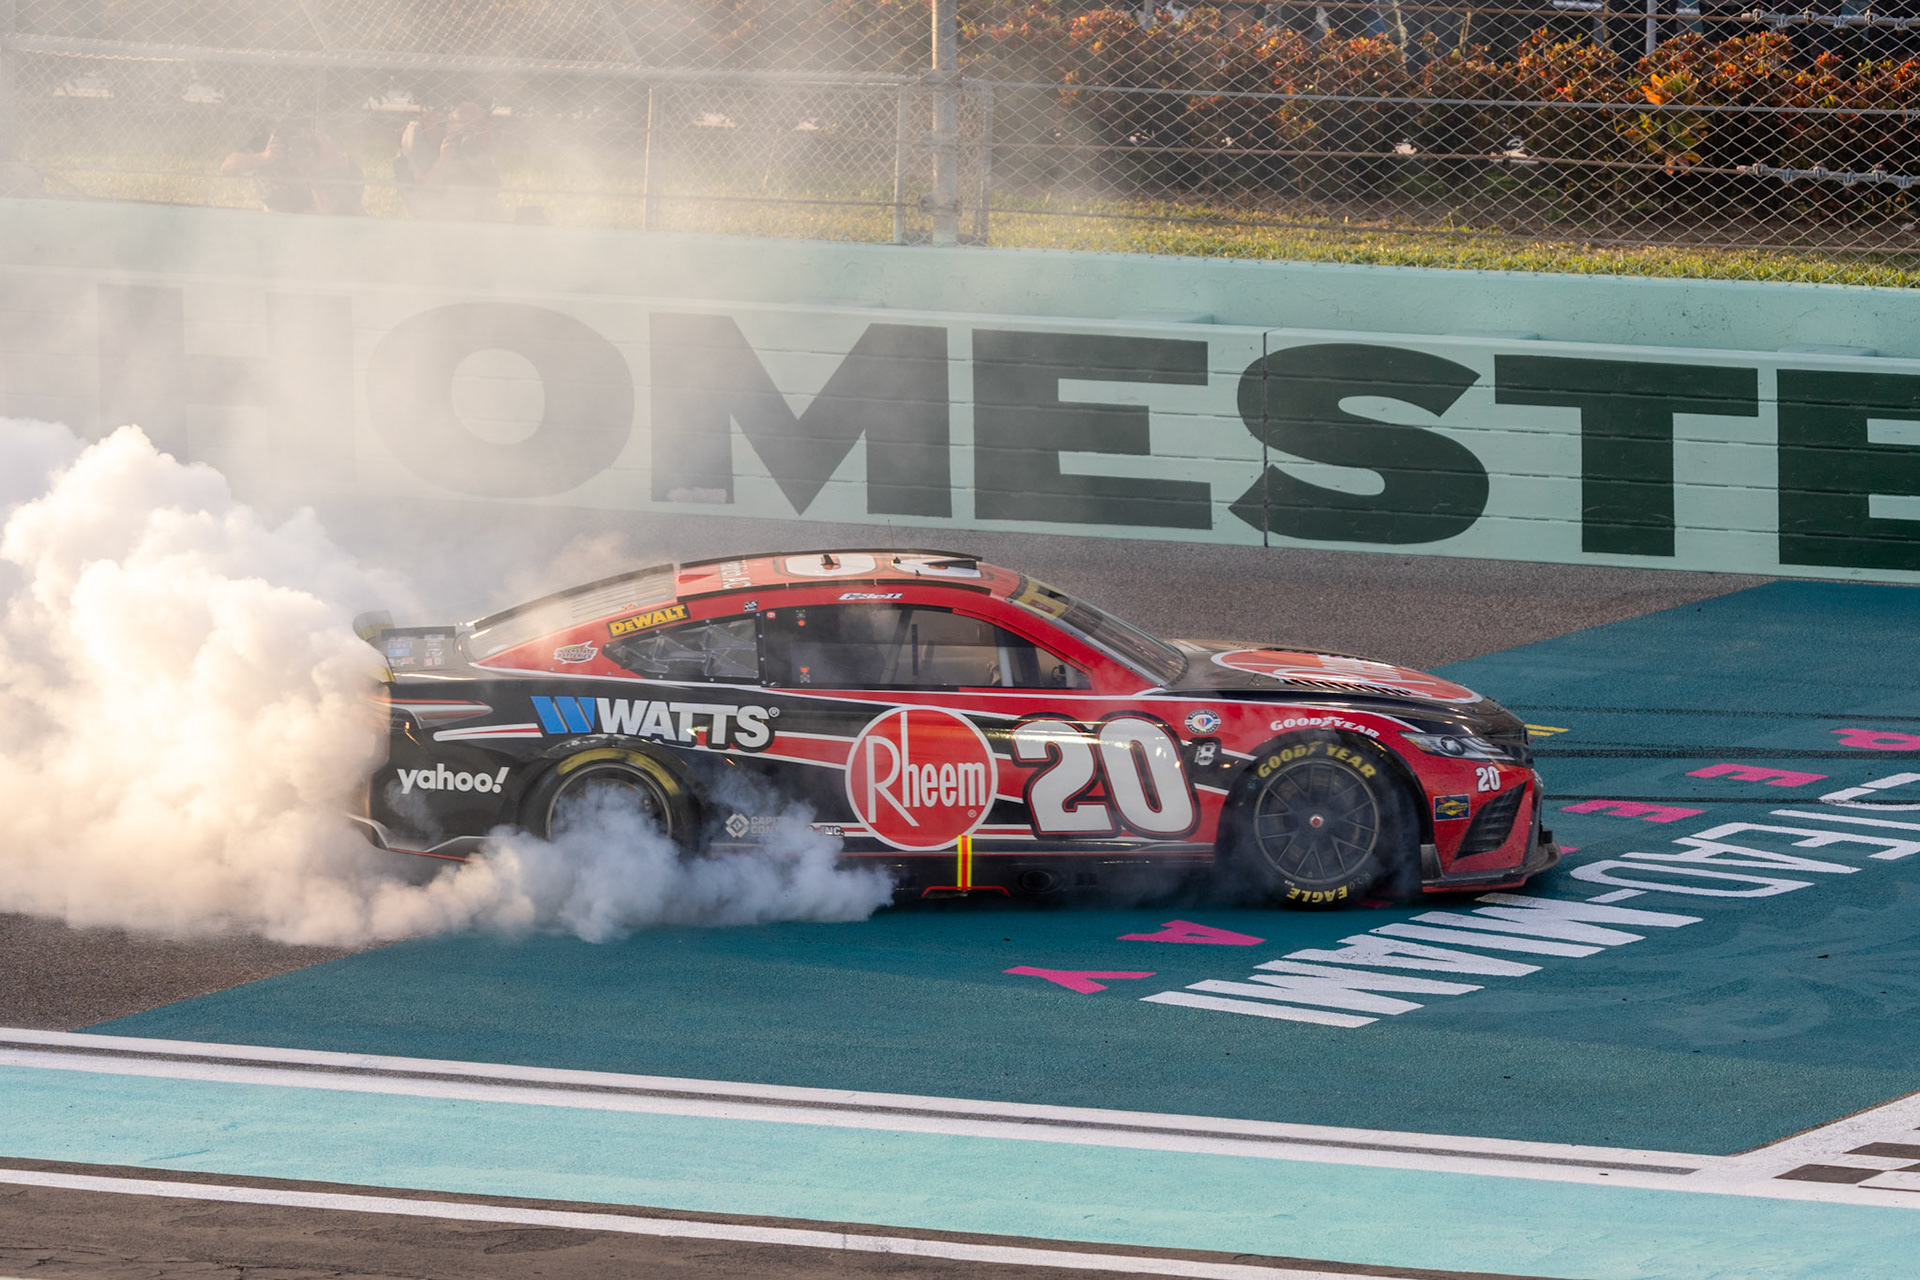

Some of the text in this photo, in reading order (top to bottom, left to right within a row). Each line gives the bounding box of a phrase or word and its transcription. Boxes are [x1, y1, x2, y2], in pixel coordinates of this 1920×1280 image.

[596, 698, 771, 748] WATTS
[1270, 716, 1380, 738] GOODYEAR
[397, 763, 509, 794] yahoo!
[866, 711, 986, 827] Rheem
[1012, 716, 1195, 834] 20
[1475, 766, 1501, 792] 20
[1286, 885, 1348, 903] EAGLE
